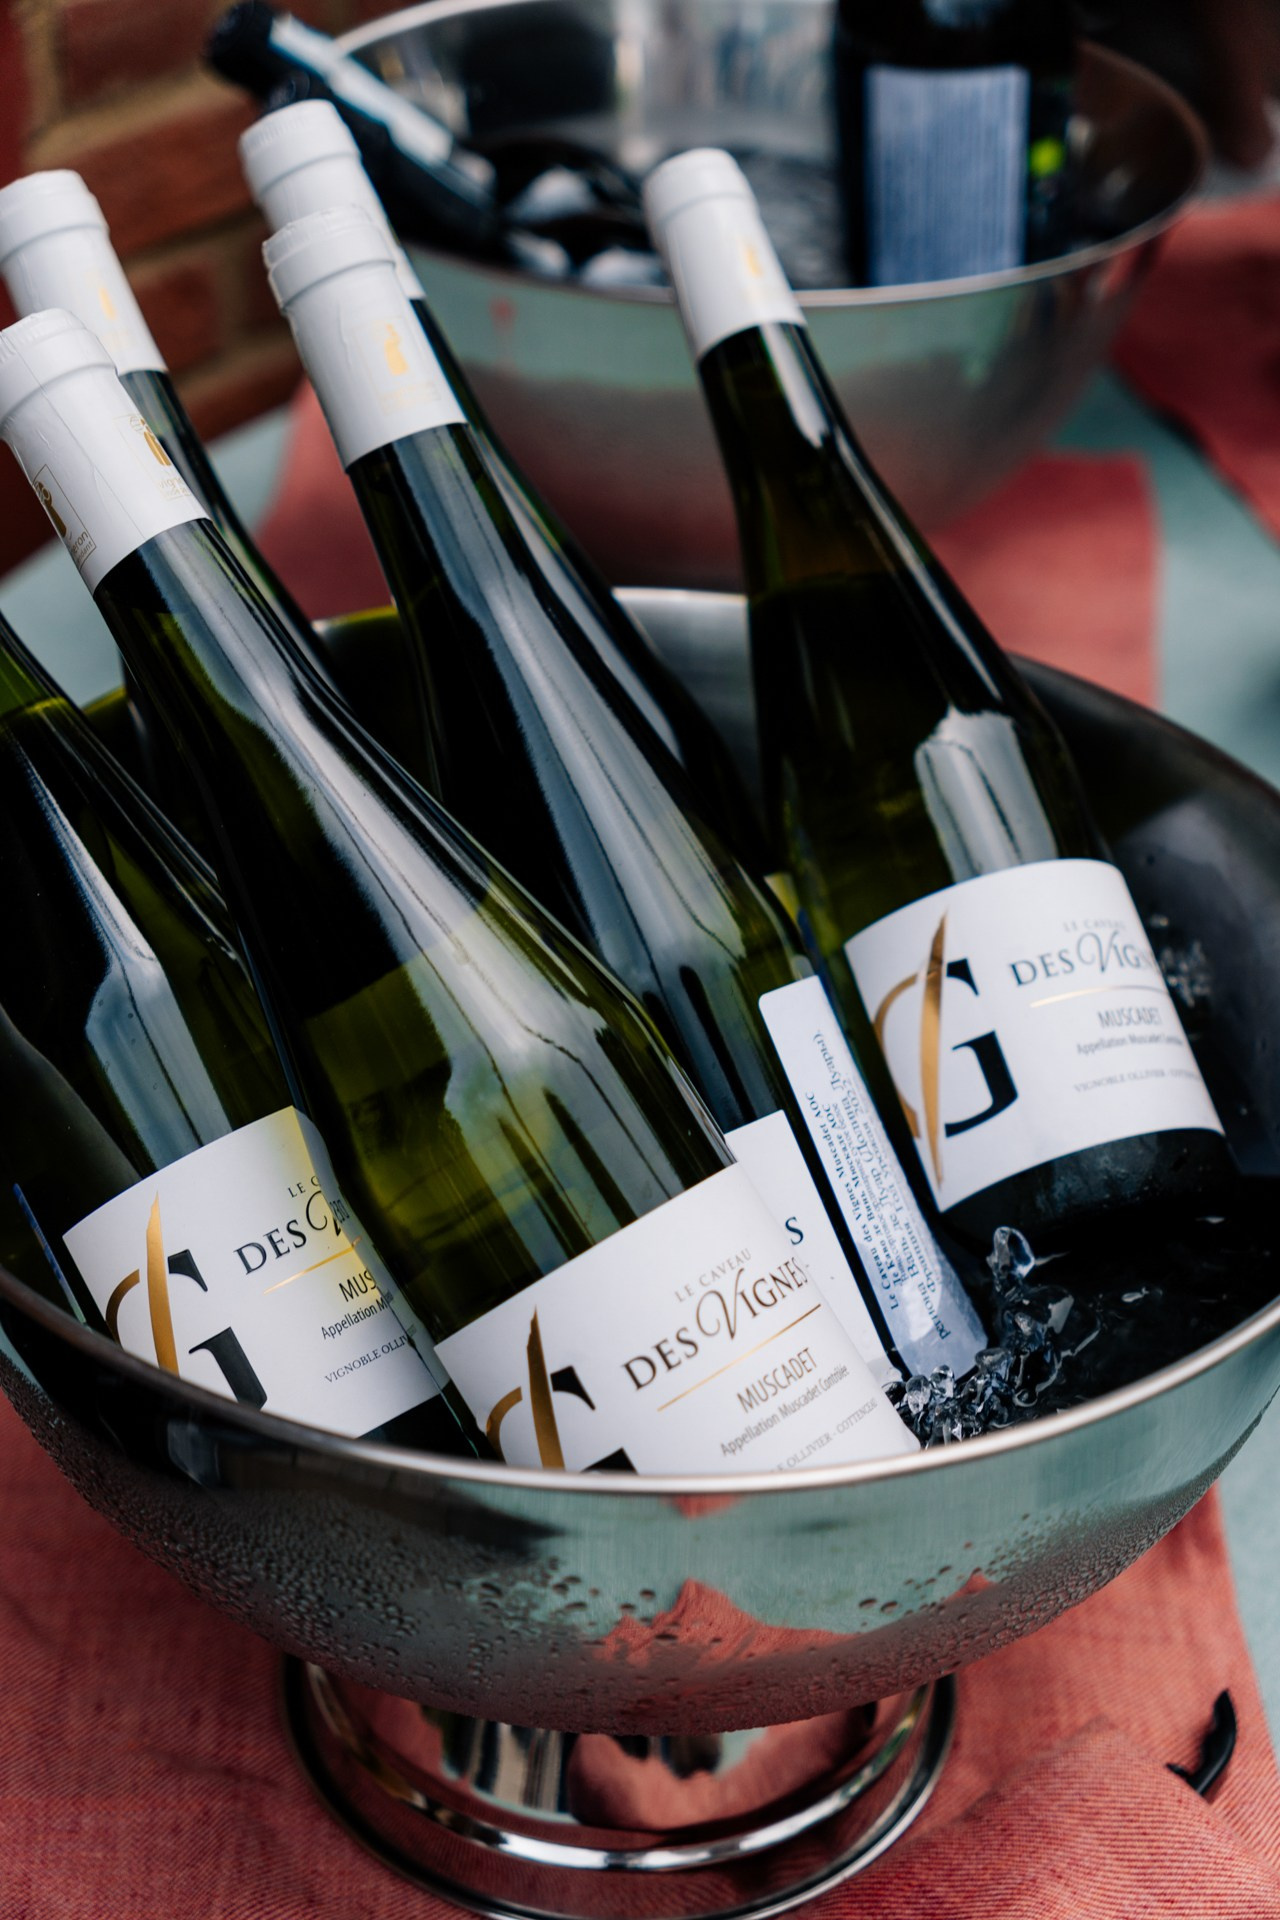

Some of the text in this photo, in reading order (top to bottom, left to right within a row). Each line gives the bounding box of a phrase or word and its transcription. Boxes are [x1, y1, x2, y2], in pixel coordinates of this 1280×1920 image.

[1010, 948, 1075, 986] DES
[288, 1182, 306, 1198] LE
[805, 1091, 898, 1308] Le Caveau des Vignes Muscadet AOC
[233, 1219, 307, 1275] DES
[675, 1247, 753, 1303] LE CAVEAU
[321, 1305, 378, 1340] Appellation
[620, 1256, 809, 1391] DES VIGNES
[325, 1348, 382, 1384] VIGNOBLE
[736, 1347, 818, 1414] MUSCADET
[720, 1412, 780, 1457] Appellation
[777, 1385, 821, 1419] Muscadet
[786, 1431, 834, 1469] OLLIVIER
